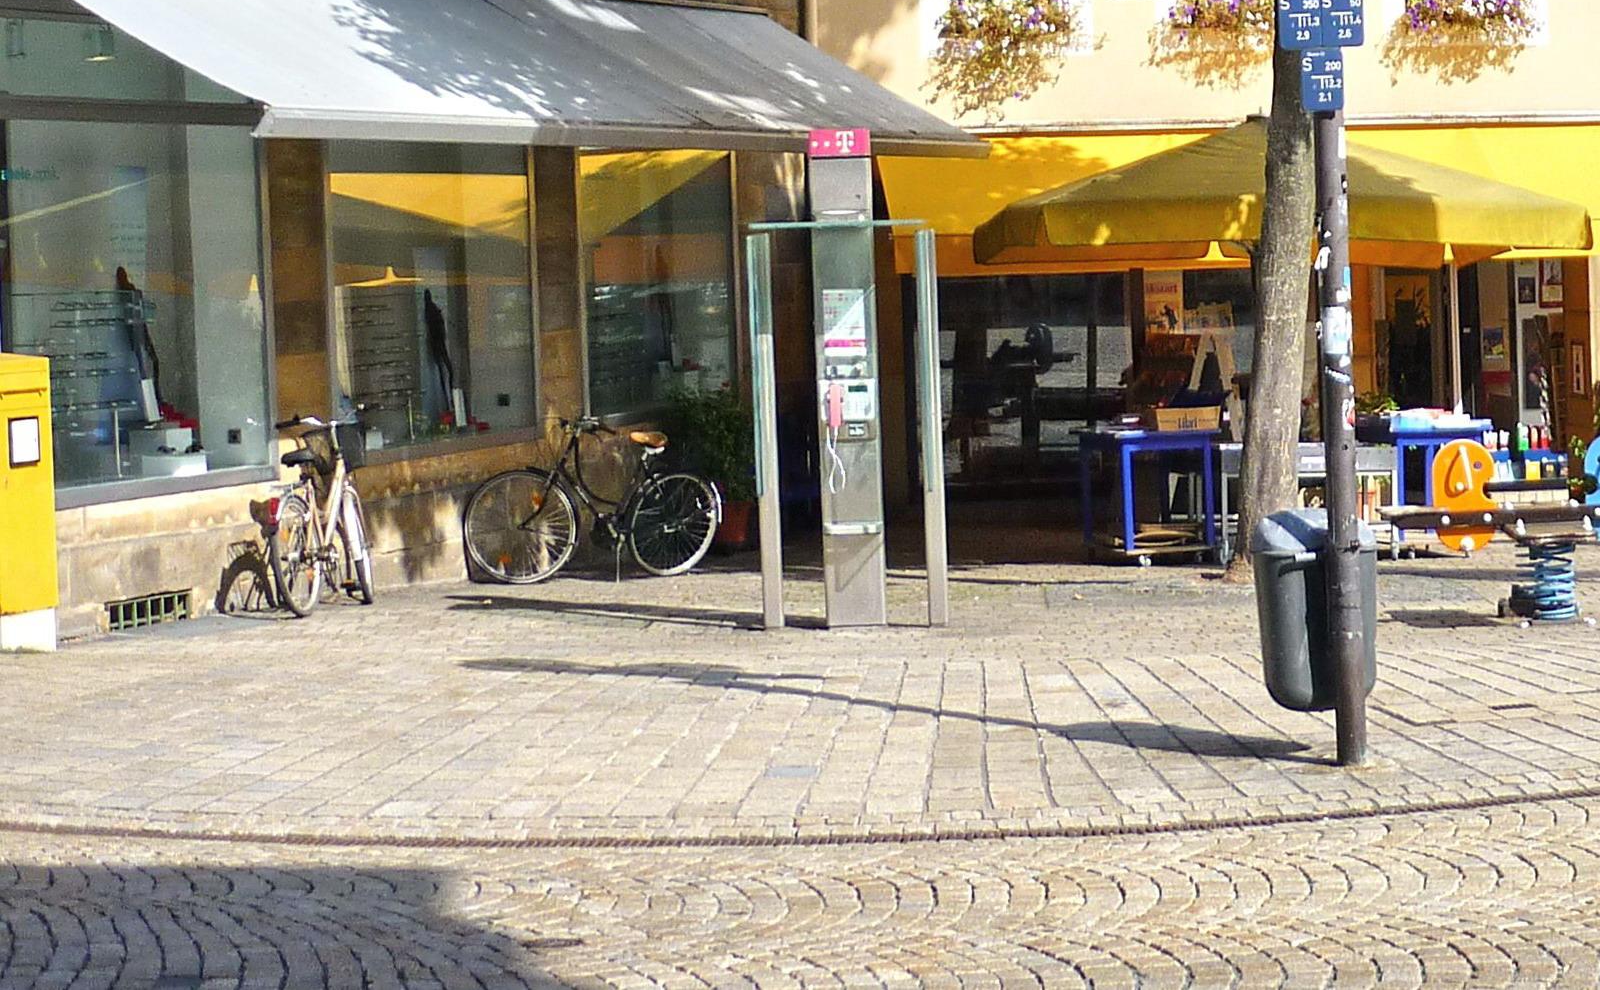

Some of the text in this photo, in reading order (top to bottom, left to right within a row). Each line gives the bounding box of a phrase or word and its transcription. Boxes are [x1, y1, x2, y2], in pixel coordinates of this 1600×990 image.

[1302, 0, 1320, 10] 350
[1302, 57, 1341, 72] S 200
